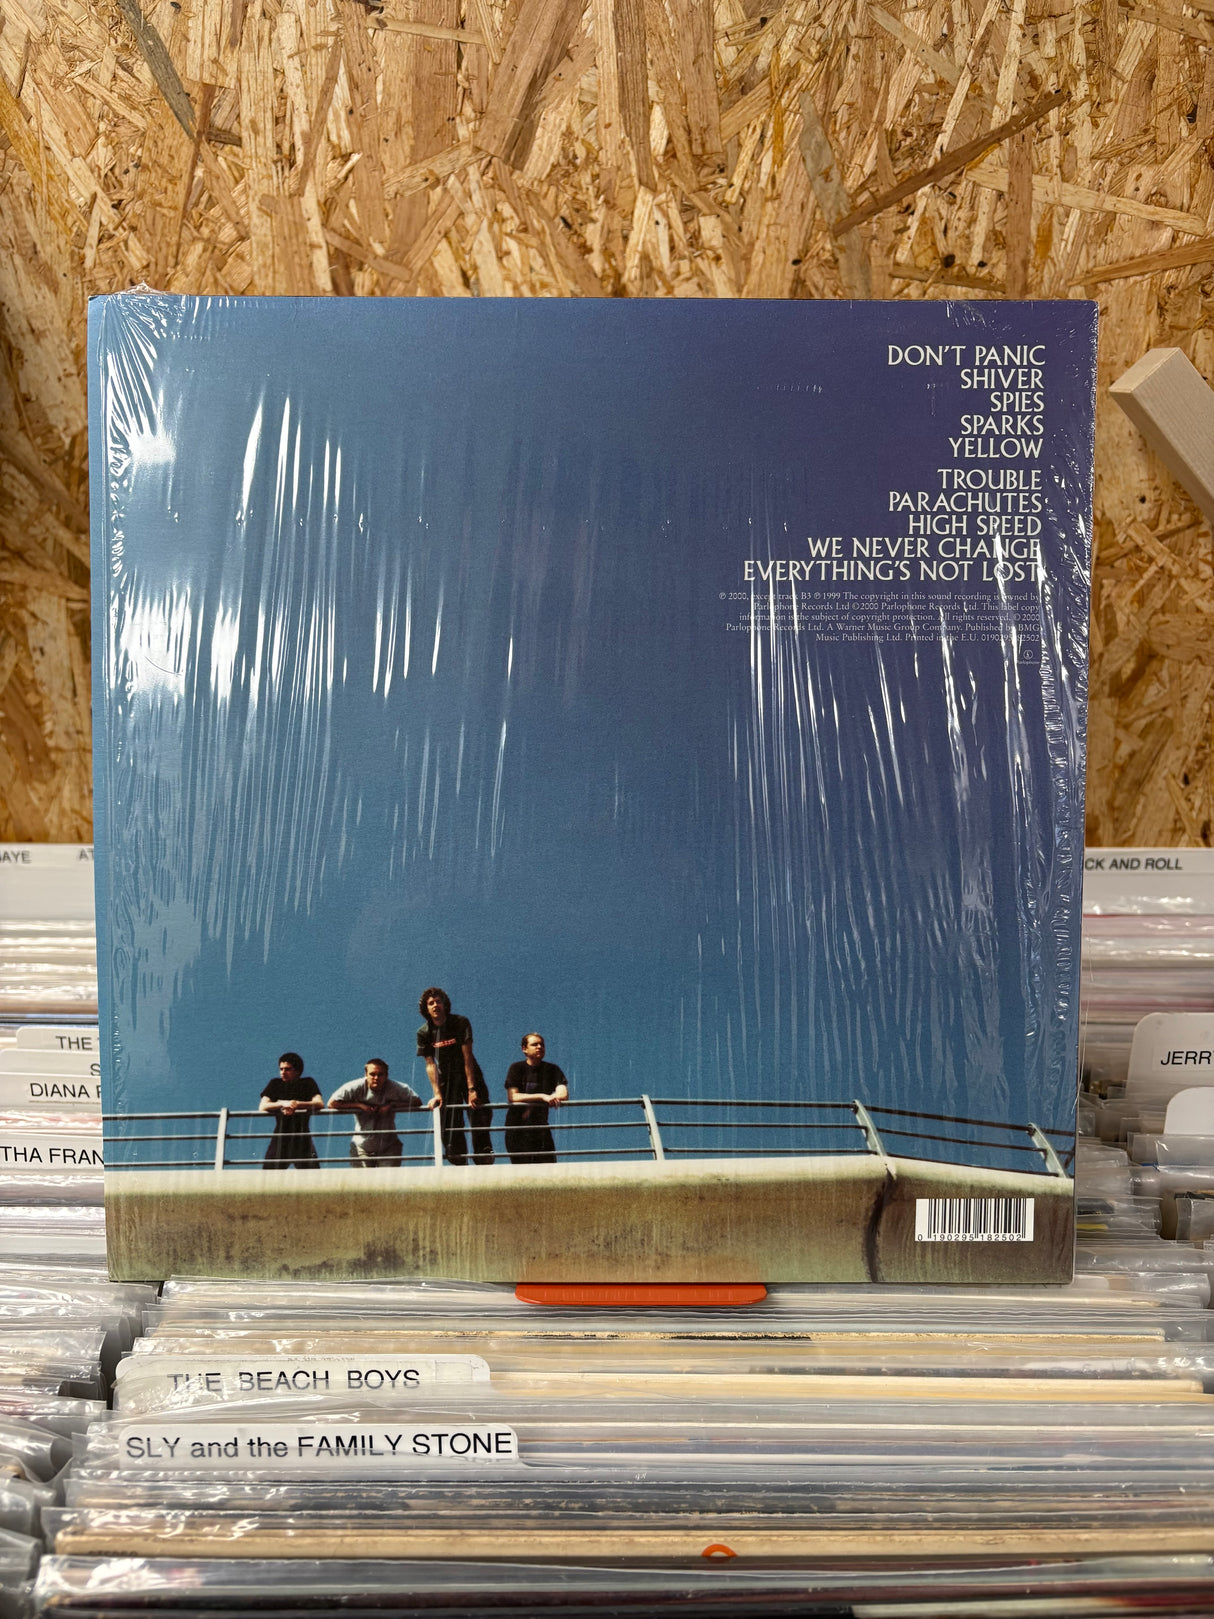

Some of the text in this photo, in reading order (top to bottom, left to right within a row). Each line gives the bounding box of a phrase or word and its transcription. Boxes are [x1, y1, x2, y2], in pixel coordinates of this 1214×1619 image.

[888, 345, 1046, 366] DON'T PANIC
[960, 368, 1044, 389] SHIVER
[990, 391, 1045, 412] SPIES
[960, 414, 1044, 435] SPARKS
[948, 437, 1043, 458] YELLOW
[937, 469, 1042, 490] TROUBLE
[888, 491, 1042, 513] PARACHUTES
[908, 514, 1042, 536] HIGH SPEED
[807, 537, 1040, 559] WE NEVER CHANGE
[743, 560, 1041, 582] EVERYTHING'S NOT LOST
[752, 593, 776, 602] excet
[801, 592, 811, 600] B3
[823, 592, 841, 600] 1999
[843, 592, 859, 600] The
[861, 592, 899, 602] copyright
[901, 592, 909, 600] in
[911, 592, 926, 600] this
[928, 592, 952, 600] sound
[954, 592, 992, 602] recording
[994, 592, 1000, 600] is
[801, 602, 833, 610] Records
[836, 602, 850, 610] Ltd
[881, 602, 927, 612] Parlophone
[929, 602, 960, 610] Records
[963, 601, 979, 611] Ltd.
[981, 602, 999, 611] This
[1001, 602, 1019, 611] label
[1021, 604, 1040, 613] copy
[788, 612, 795, 620] is
[811, 612, 839, 622] subject
[841, 612, 850, 620] of
[851, 612, 890, 622] copyright
[893, 612, 935, 622] protection.
[952, 612, 974, 622] rights
[1022, 613, 1040, 621] 2000
[808, 623, 824, 631] Ltd.
[827, 623, 834, 631] A
[836, 623, 865, 631] Warner
[867, 623, 891, 631] Music
[893, 623, 920, 634] Group
[965, 623, 1003, 632] Published
[1018, 623, 1040, 632] BMG
[816, 633, 840, 641] Music
[842, 633, 884, 643] Publishing
[886, 633, 902, 641] Ltd.
[961, 633, 979, 641] E.U.
[0, 850, 31, 865] AYE
[1108, 857, 1140, 871] AND
[1144, 857, 1184, 871] ROLL
[55, 1036, 93, 1051] THE
[1160, 1050, 1214, 1066] JERR
[30, 1082, 90, 1099] DIANA
[0, 1145, 104, 1165] THA FRAN
[239, 1370, 330, 1391] BEACH
[347, 1369, 421, 1390] BOYS
[126, 1432, 512, 1458] SLY and the FAMILY STONE
